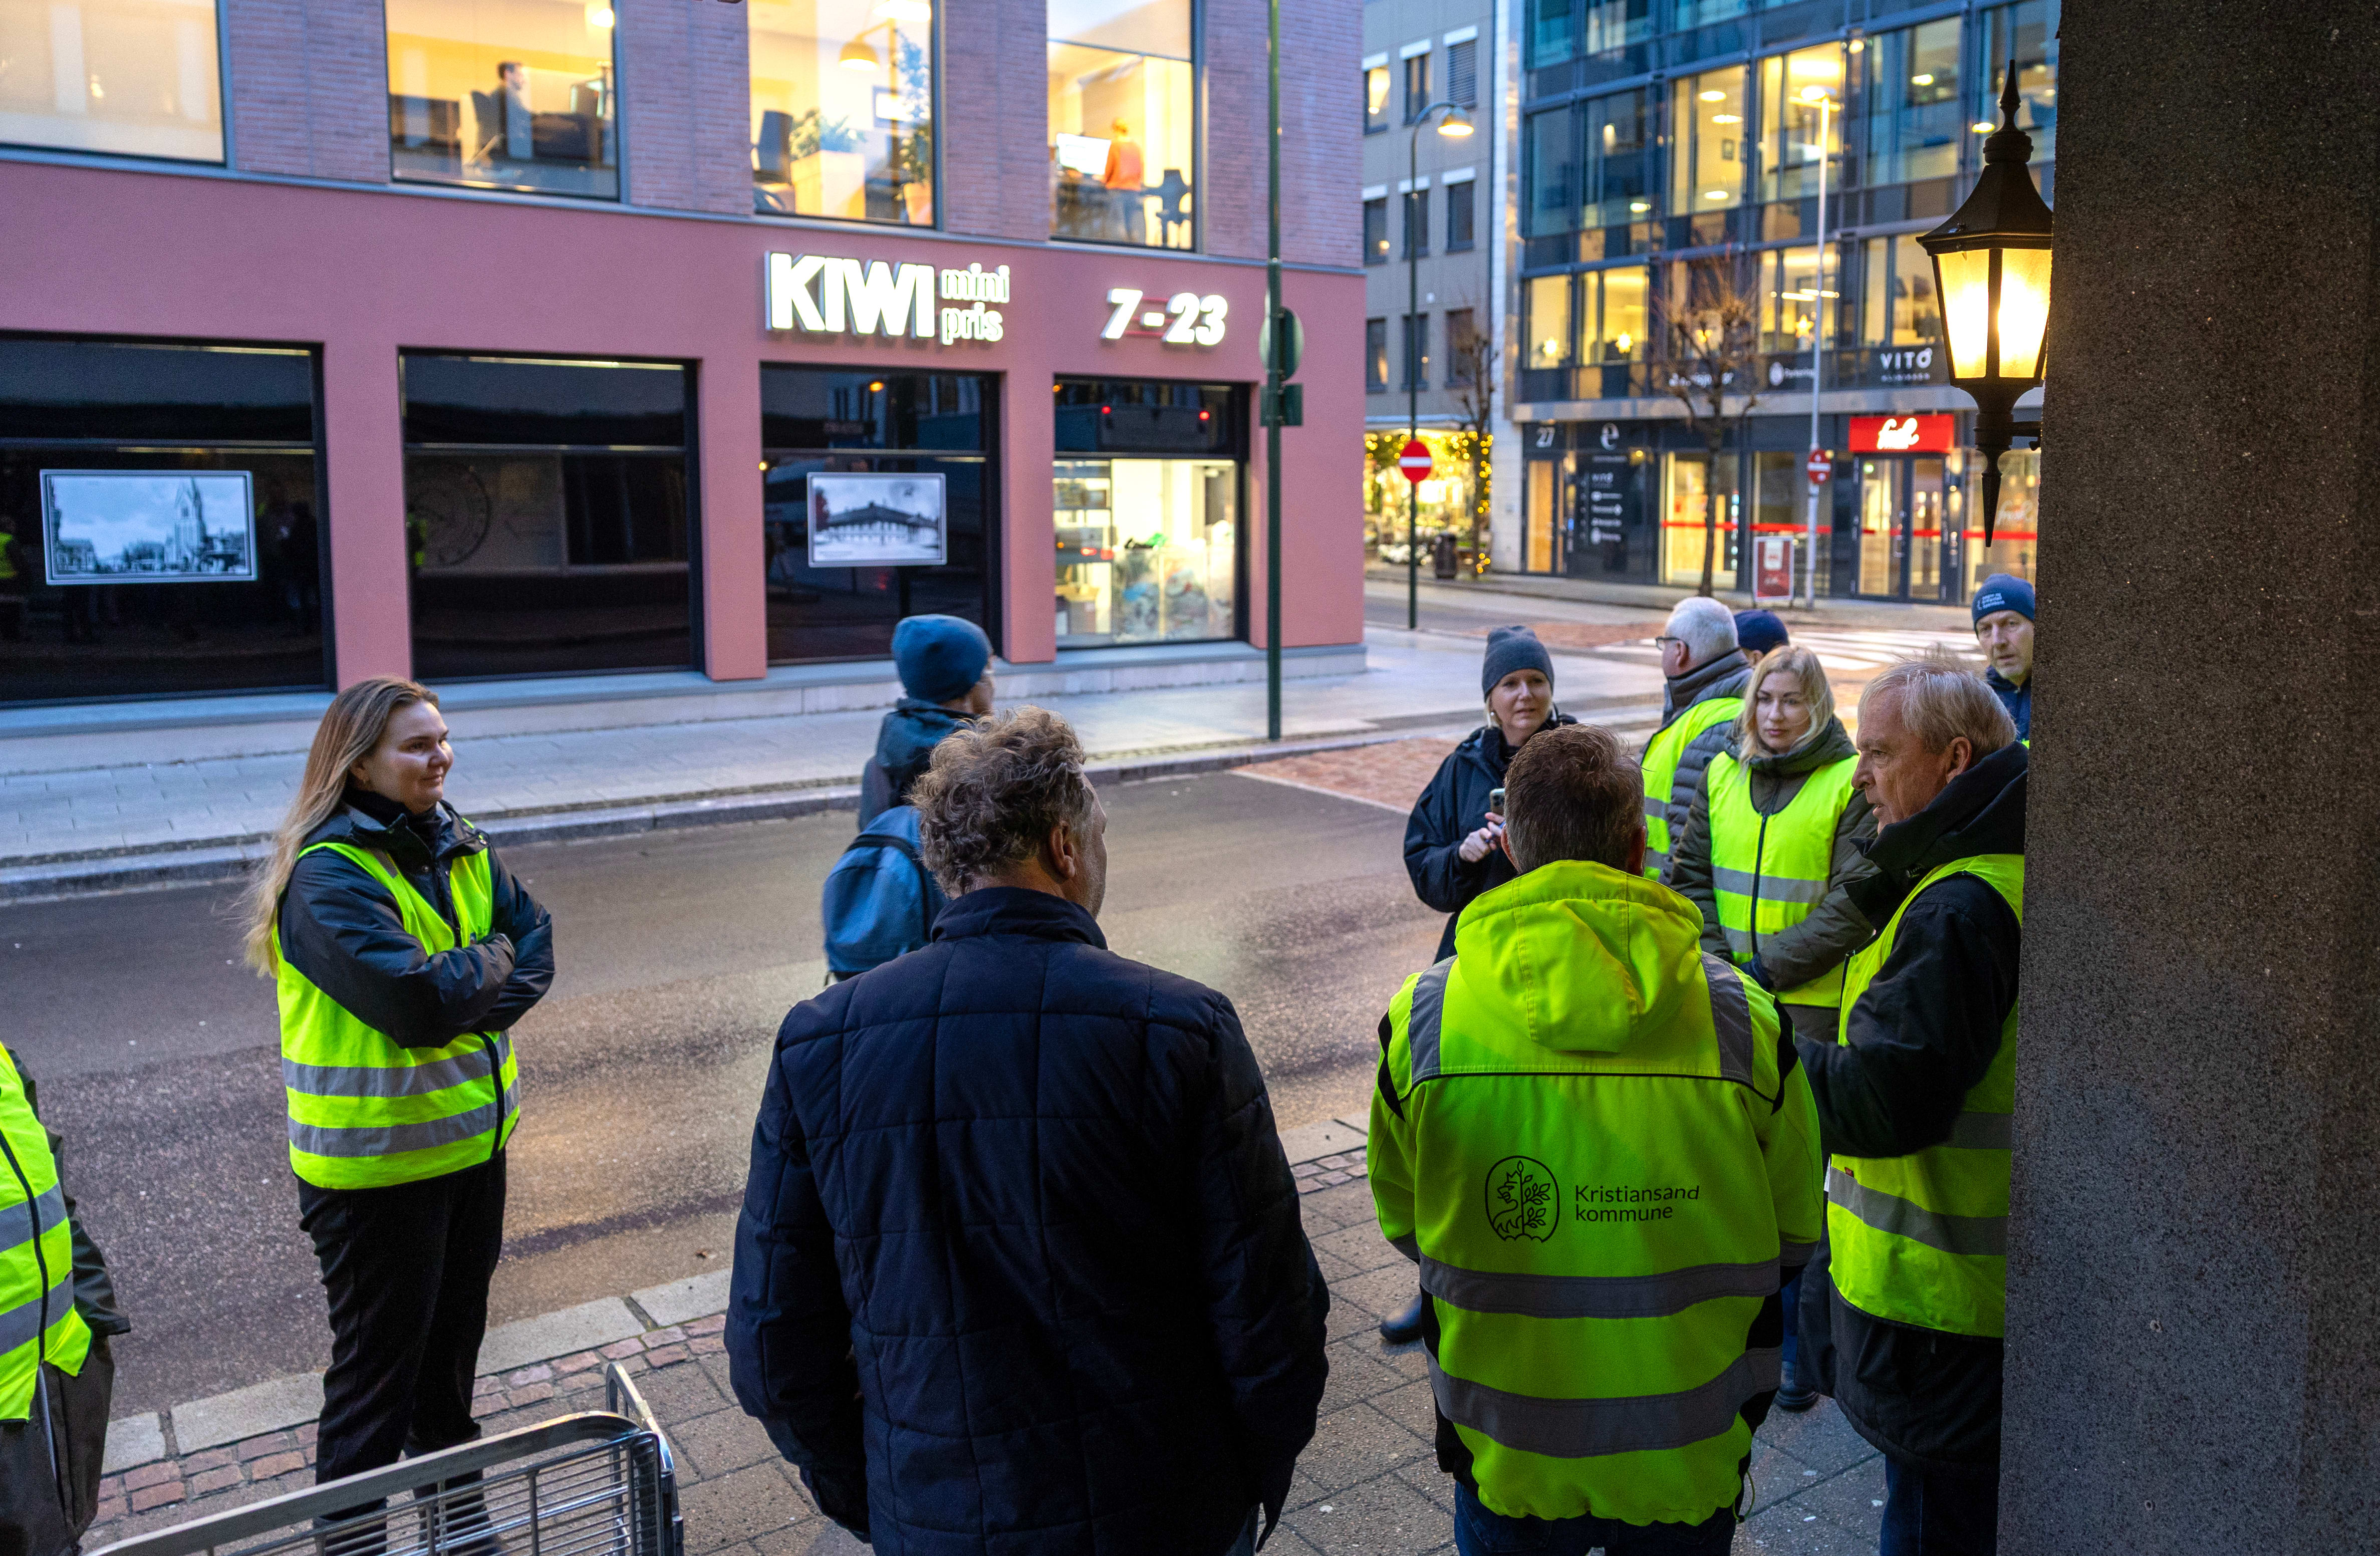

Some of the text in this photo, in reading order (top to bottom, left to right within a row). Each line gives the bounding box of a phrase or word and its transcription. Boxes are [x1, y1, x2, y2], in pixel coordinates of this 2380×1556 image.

[766, 251, 935, 338] KIWI
[940, 262, 1010, 304] mini
[941, 301, 1004, 345] pris
[1575, 1185, 1700, 1203] Kristiansand
[1575, 1203, 1674, 1222] kommune
